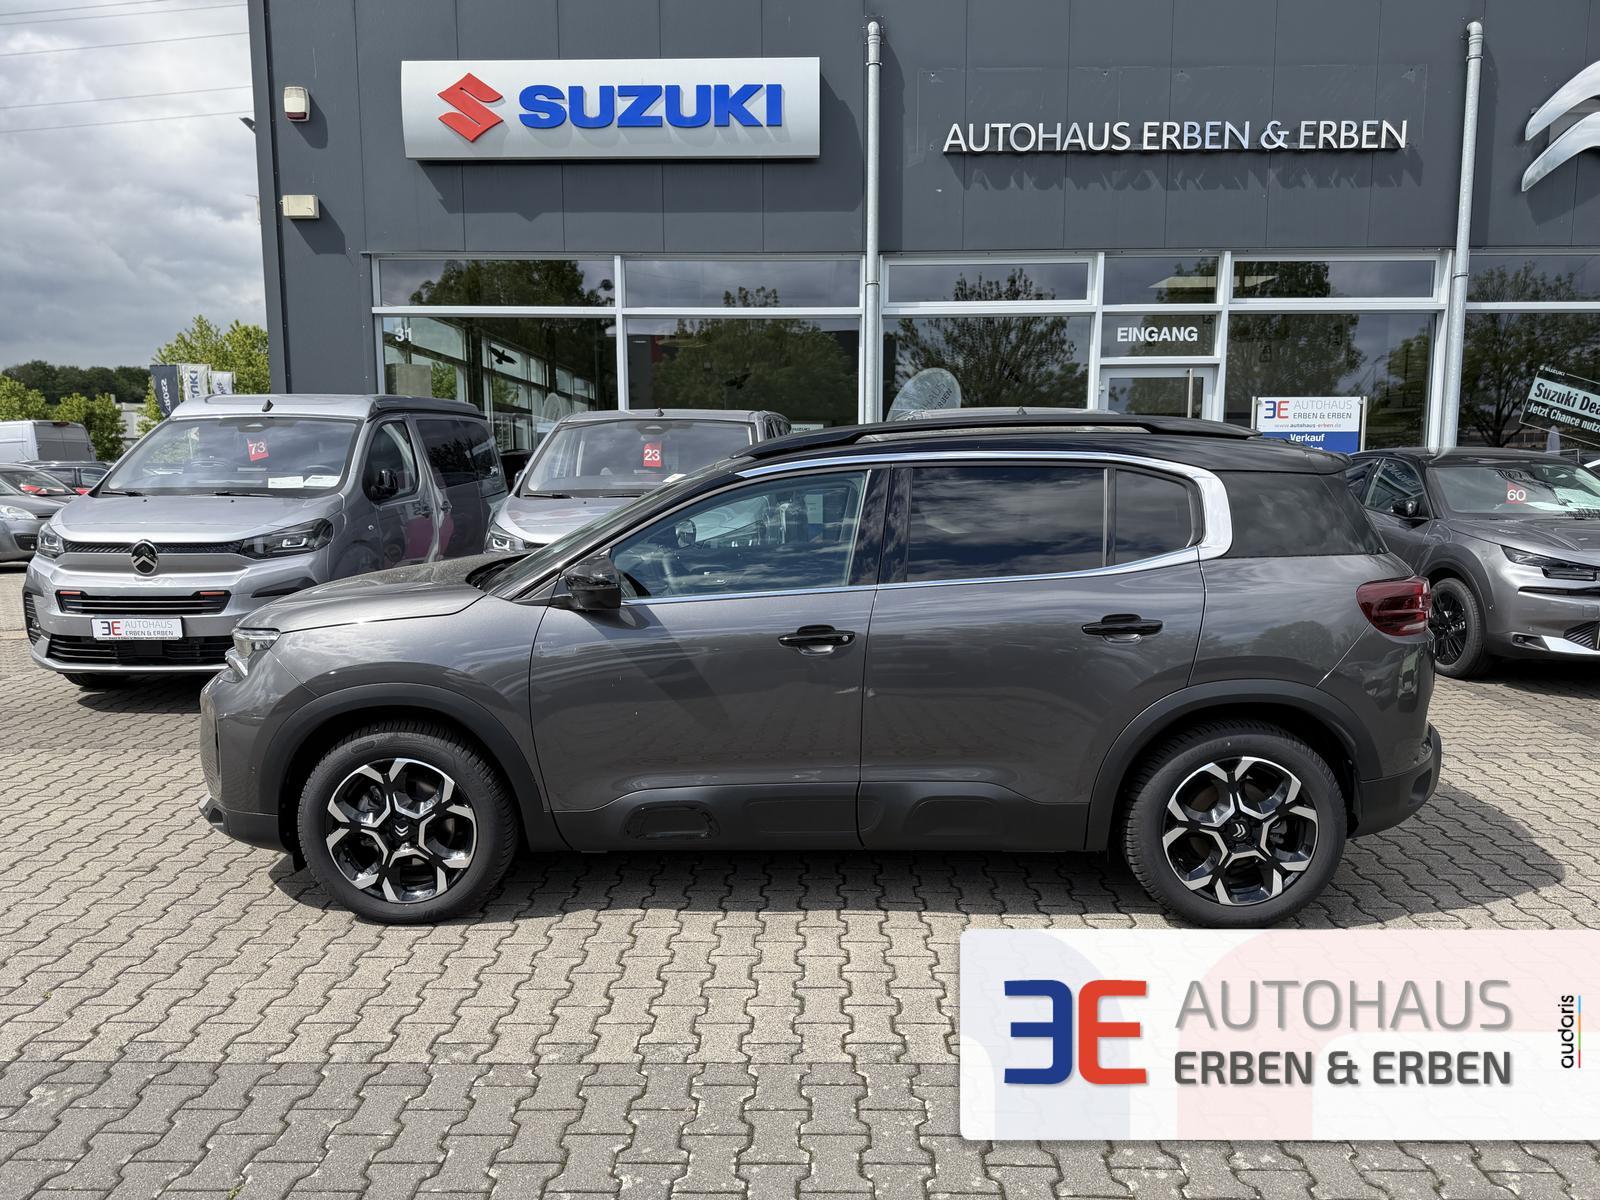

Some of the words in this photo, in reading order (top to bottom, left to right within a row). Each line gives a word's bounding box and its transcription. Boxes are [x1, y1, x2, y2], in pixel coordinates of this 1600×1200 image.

[518, 84, 783, 129] SUZUKI
[943, 121, 1132, 152] AUTOHAUS
[1142, 121, 1250, 150] ERBEN
[1260, 120, 1290, 149] &
[1299, 119, 1408, 149] ERBEN
[394, 327, 412, 342] 31
[1117, 326, 1199, 342] EINGANG
[1534, 382, 1579, 408] Suzuki
[1293, 400, 1353, 410] AUTOHAUS
[1293, 412, 1318, 420] ERBEN
[1319, 412, 1327, 420] &
[1327, 412, 1352, 420] ERBEN
[1528, 402, 1549, 418] Jetzt
[1550, 409, 1580, 426] Chance
[1290, 433, 1326, 442] Verkauf
[248, 441, 266, 455] 73
[644, 449, 660, 461] 23
[1507, 489, 1526, 501] 60
[125, 621, 173, 629] AUTOHAUS
